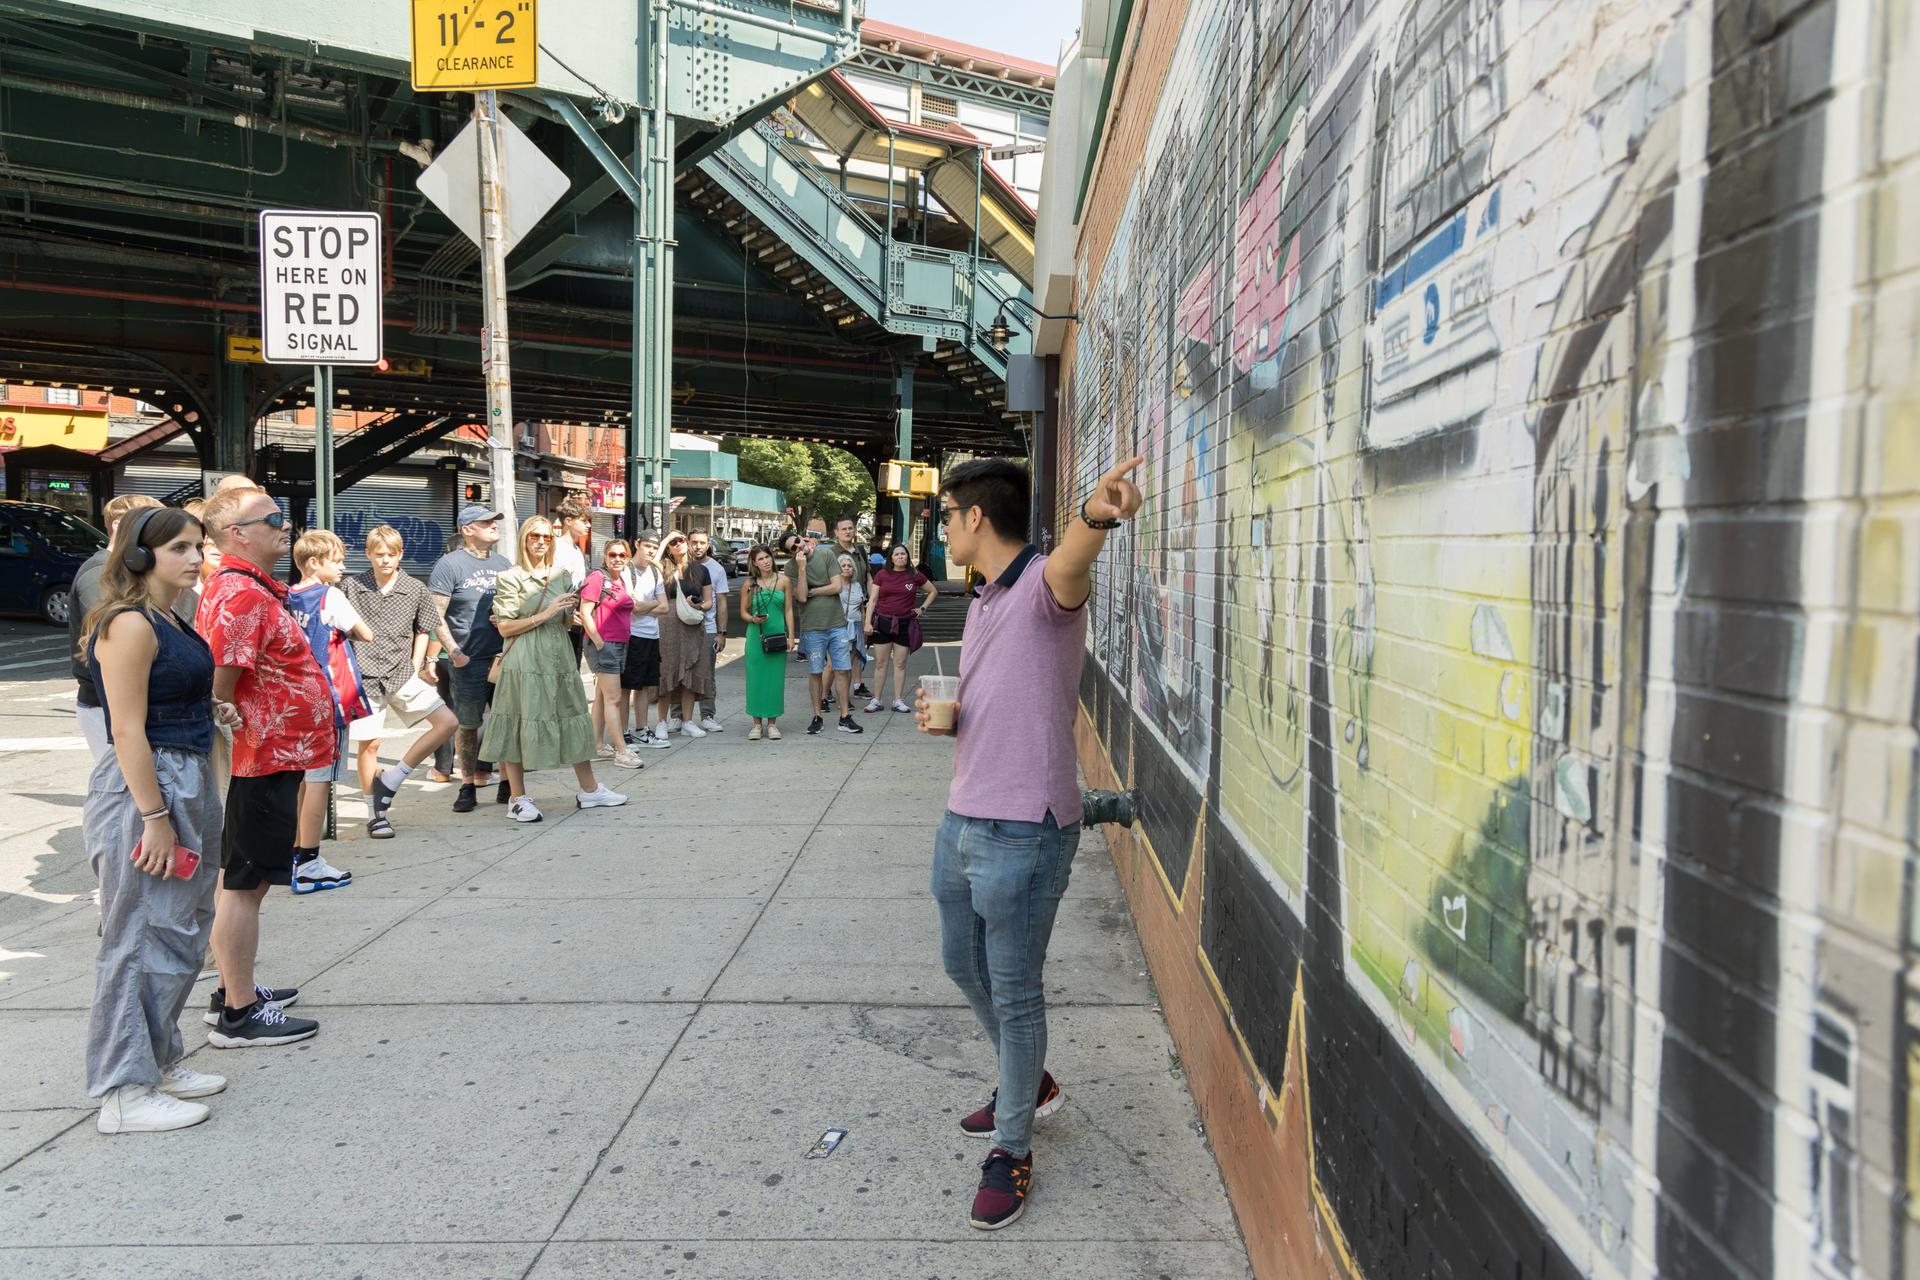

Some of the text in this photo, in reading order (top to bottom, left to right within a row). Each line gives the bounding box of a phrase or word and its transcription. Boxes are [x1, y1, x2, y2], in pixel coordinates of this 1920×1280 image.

[437, 55, 514, 71] CLEARANCE
[273, 225, 369, 259] STOP
[276, 267, 366, 285] HERE ON
[284, 292, 360, 326] RED
[287, 332, 358, 351] SIGNAL
[48, 481, 70, 489] ATM
